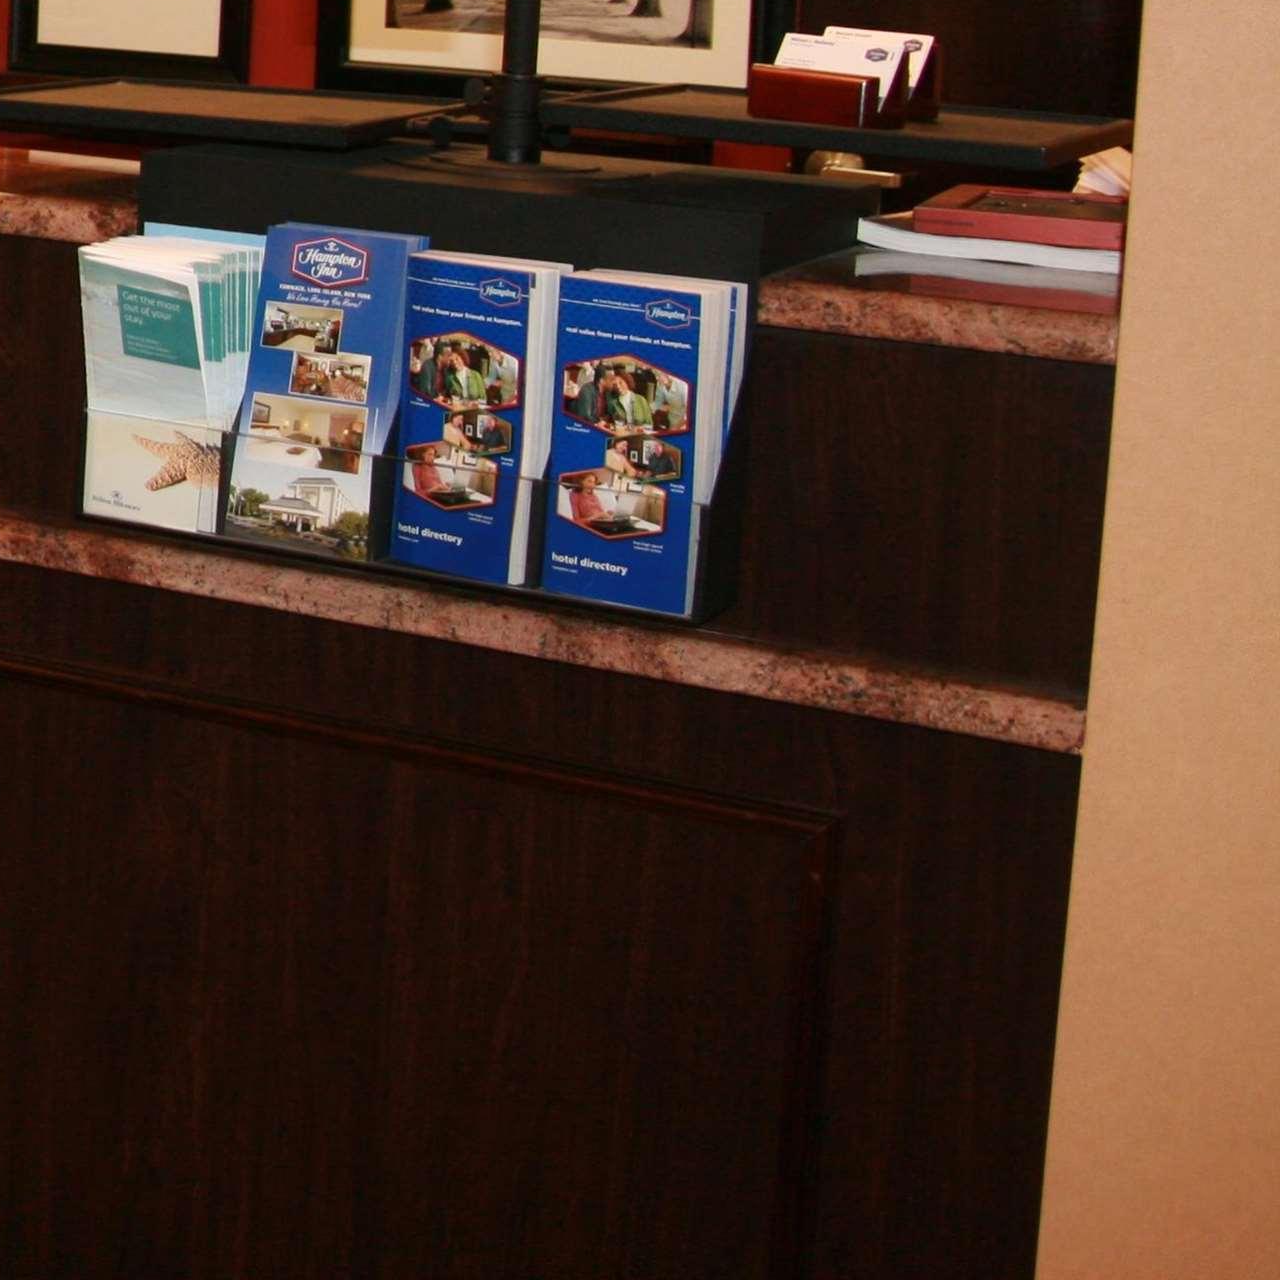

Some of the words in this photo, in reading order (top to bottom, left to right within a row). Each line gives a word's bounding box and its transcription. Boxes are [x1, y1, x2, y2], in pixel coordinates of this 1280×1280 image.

[298, 247, 362, 268] Hampton
[310, 263, 343, 279] Inn
[122, 290, 139, 302] Get
[140, 295, 156, 306] the
[156, 300, 181, 313] most
[481, 285, 520, 299] Hampton
[122, 303, 139, 313] out
[151, 310, 173, 322] your
[647, 306, 689, 321] Hampton
[398, 522, 419, 536] hotel
[420, 526, 463, 546] directory
[551, 552, 578, 566] hotel
[579, 556, 628, 576] directory
